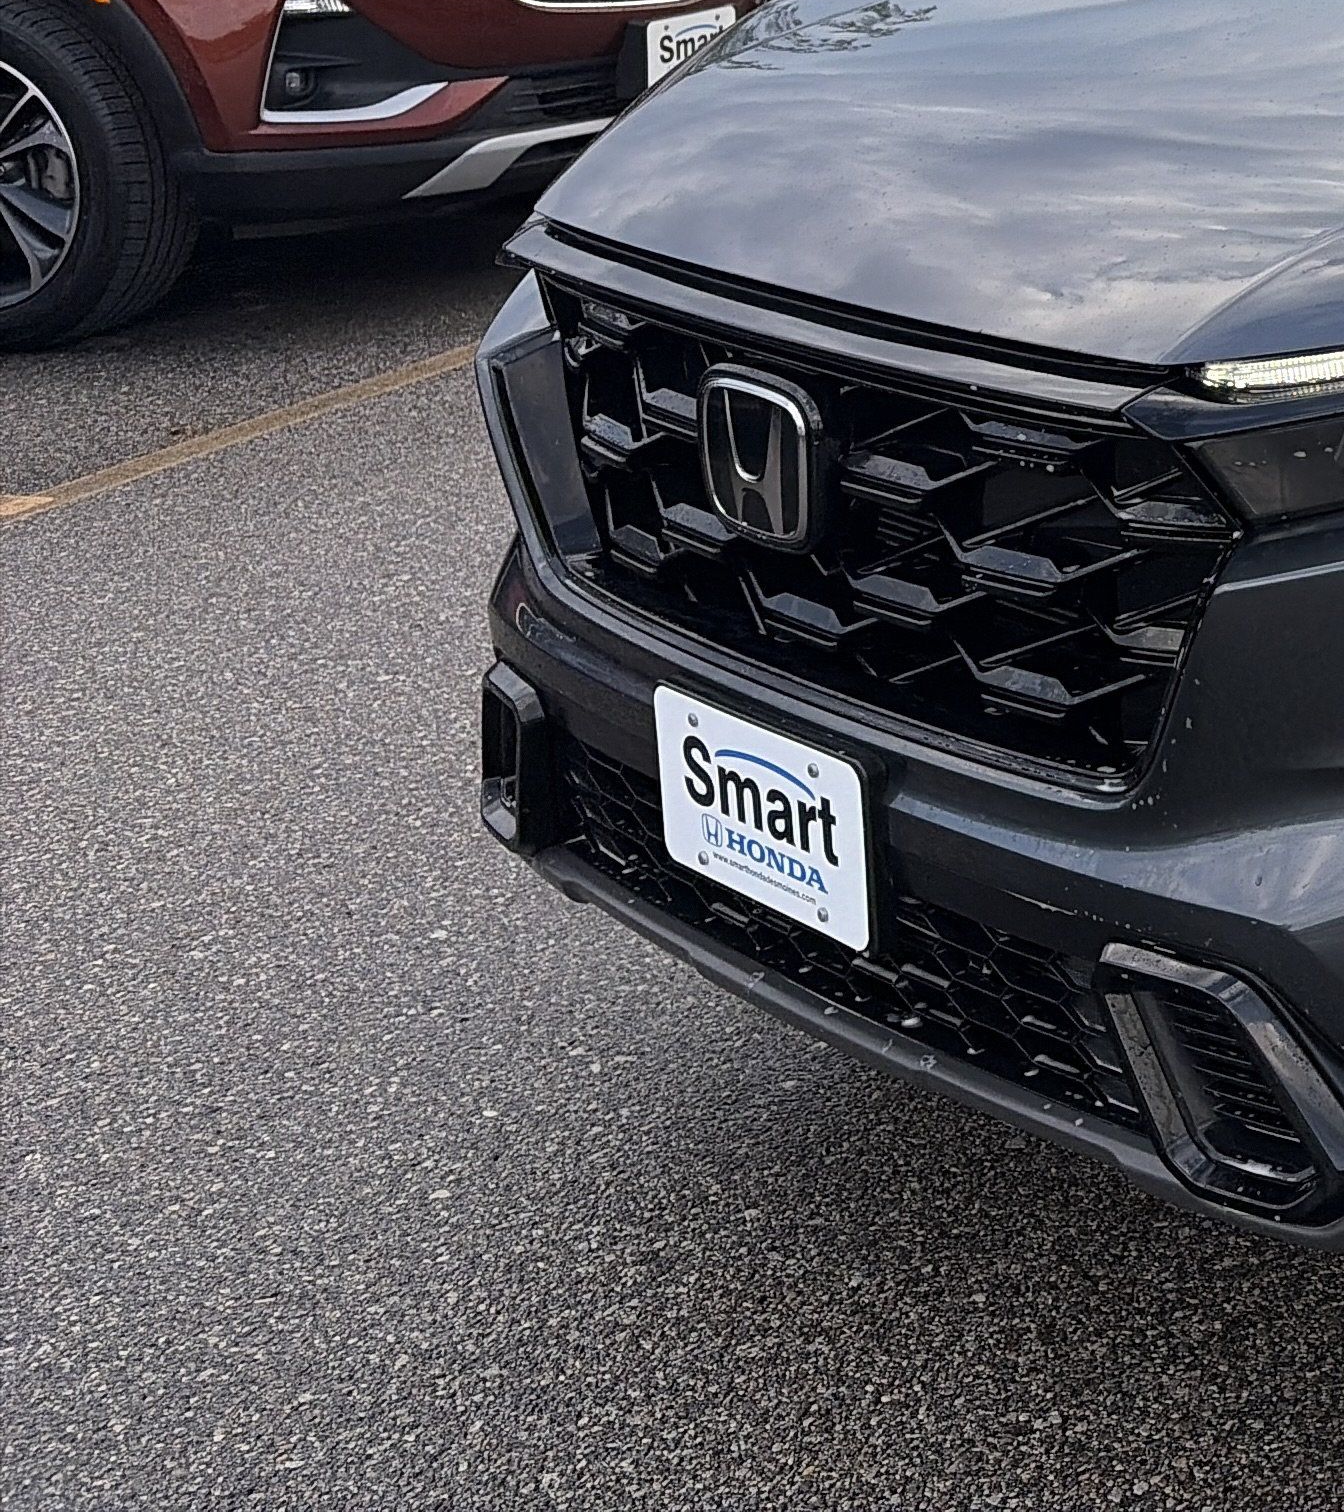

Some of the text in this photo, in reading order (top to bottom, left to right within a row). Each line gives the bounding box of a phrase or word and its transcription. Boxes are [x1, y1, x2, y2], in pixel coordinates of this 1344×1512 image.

[659, 24, 724, 64] Sma
[682, 734, 839, 867] Smart
[725, 827, 829, 895] HONDA
